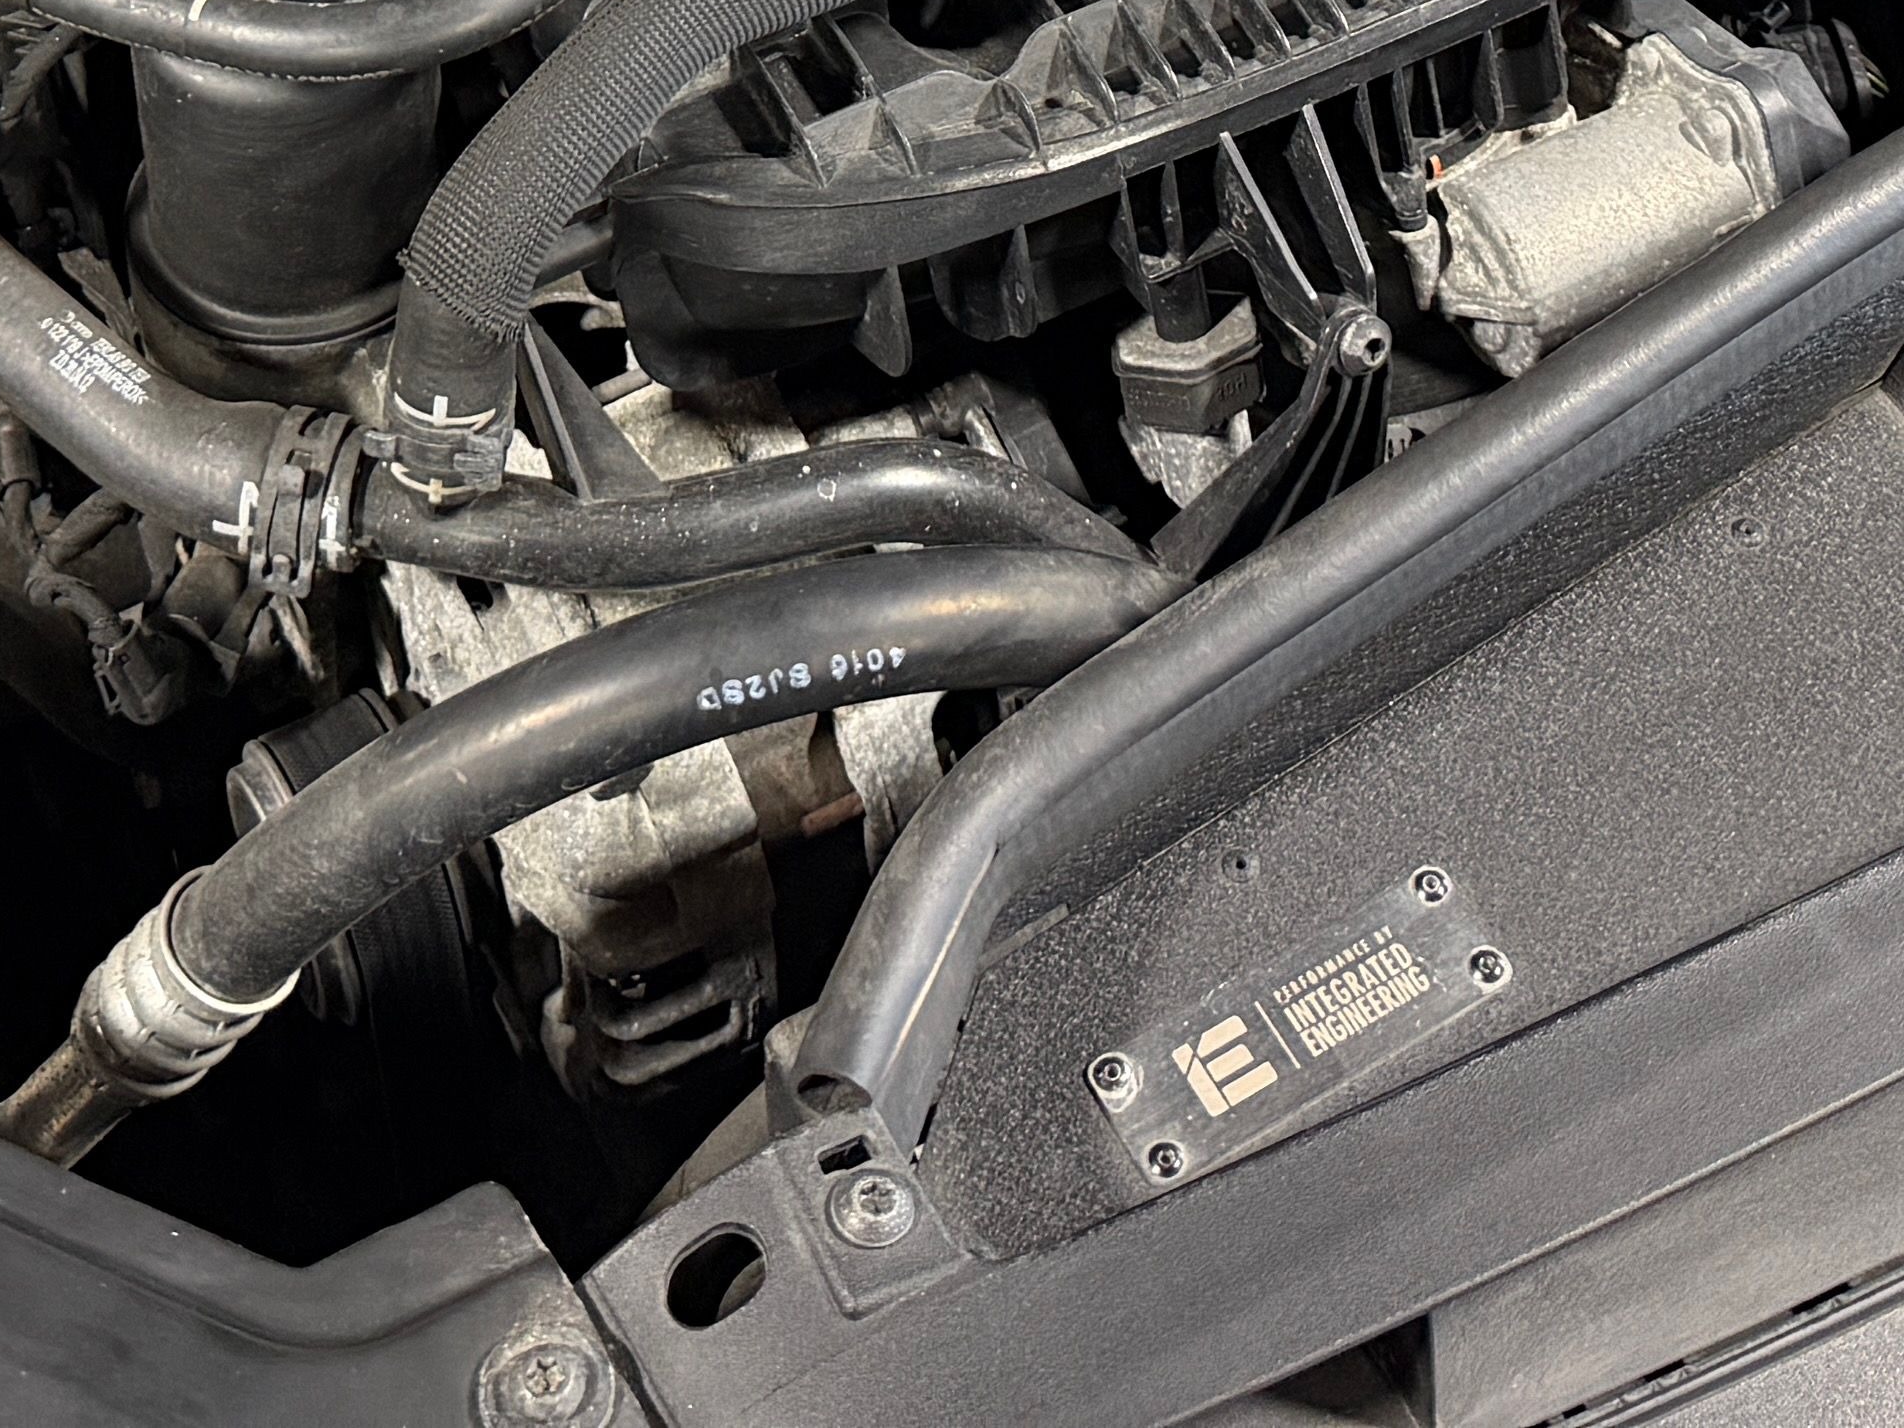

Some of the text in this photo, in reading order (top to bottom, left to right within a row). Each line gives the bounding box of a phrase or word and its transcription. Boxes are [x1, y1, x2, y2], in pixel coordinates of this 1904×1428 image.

[829, 646, 907, 681] 4016
[1273, 926, 1393, 1002] PERFORMANCE BY
[1283, 942, 1413, 1033] INTEGRATED
[1299, 966, 1432, 1058] ENGINEERING
